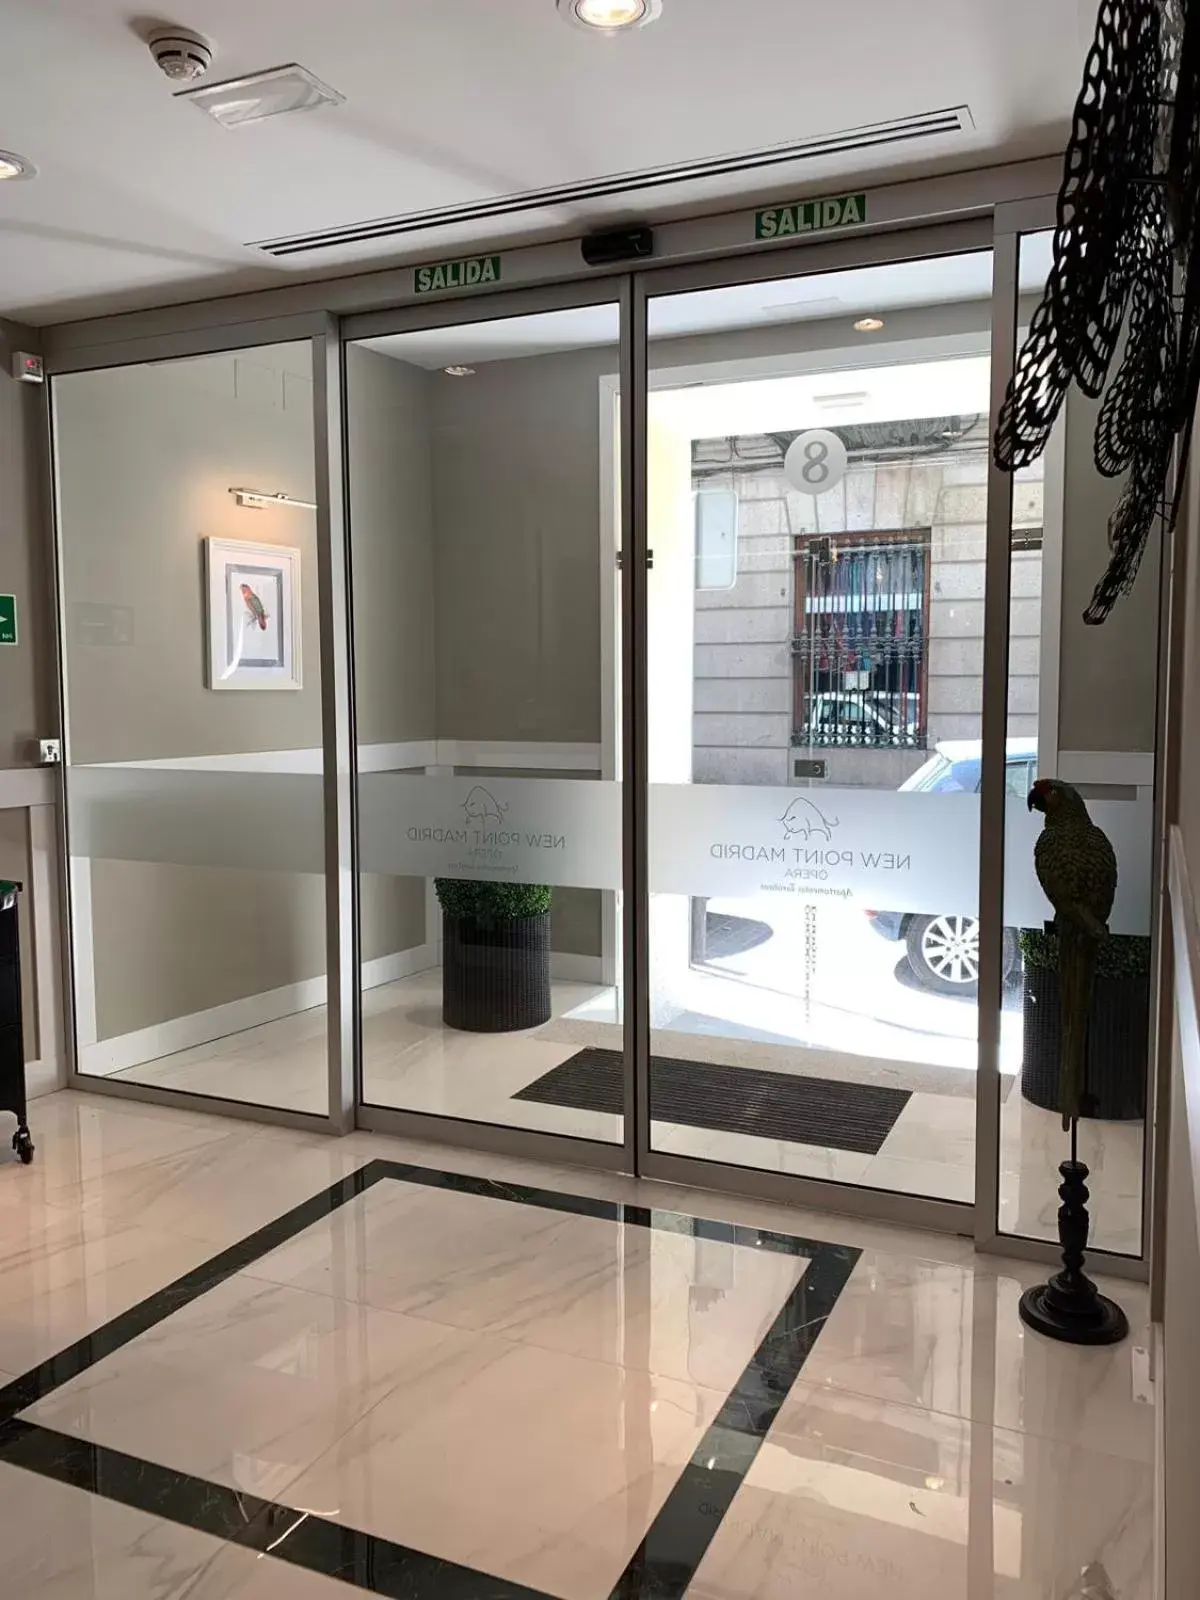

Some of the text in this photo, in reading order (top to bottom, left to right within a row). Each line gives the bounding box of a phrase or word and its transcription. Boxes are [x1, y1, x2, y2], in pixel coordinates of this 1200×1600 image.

[760, 197, 860, 237] SALIDA
[418, 258, 496, 292] SALIDA
[802, 440, 829, 484] 8
